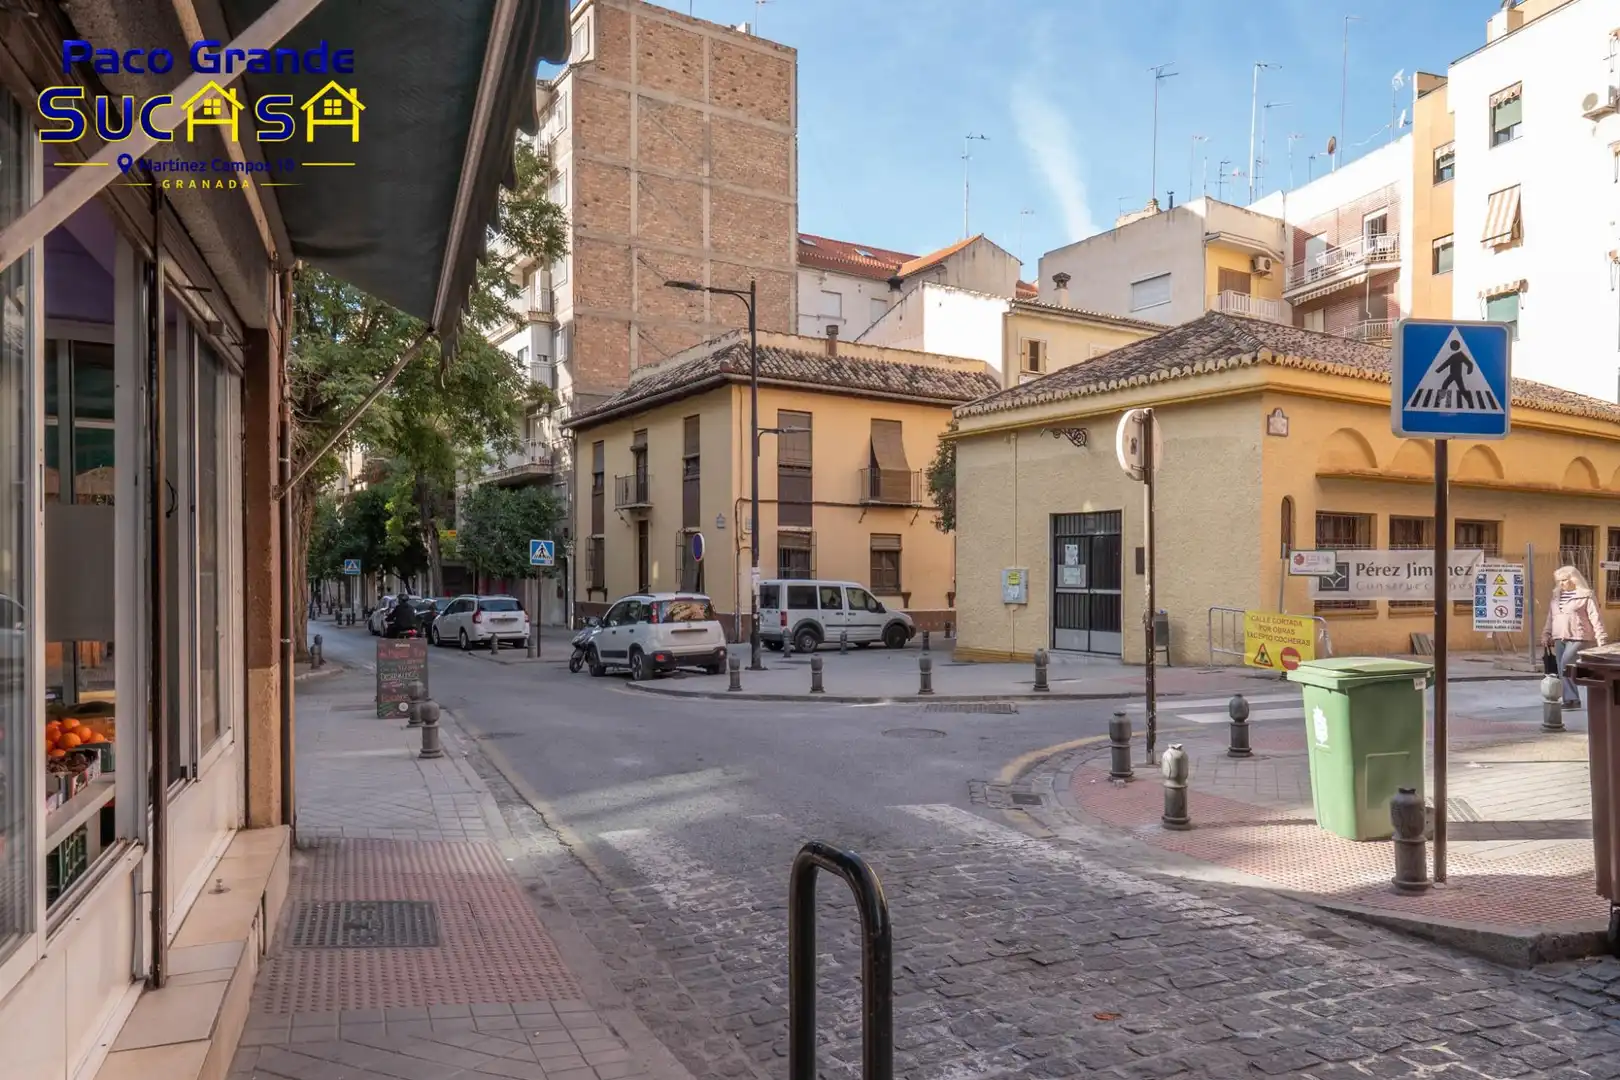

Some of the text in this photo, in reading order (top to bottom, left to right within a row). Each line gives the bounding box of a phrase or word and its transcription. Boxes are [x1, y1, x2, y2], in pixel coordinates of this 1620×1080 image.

[1356, 561, 1472, 579] Pérez Jimnez
[1356, 581, 1474, 592] Construccnes
[1251, 615, 1302, 627] CALLE CORTADA
[1259, 624, 1296, 635] POR OBRAS
[1246, 630, 1311, 647] EXCEPTO COCHERAS
